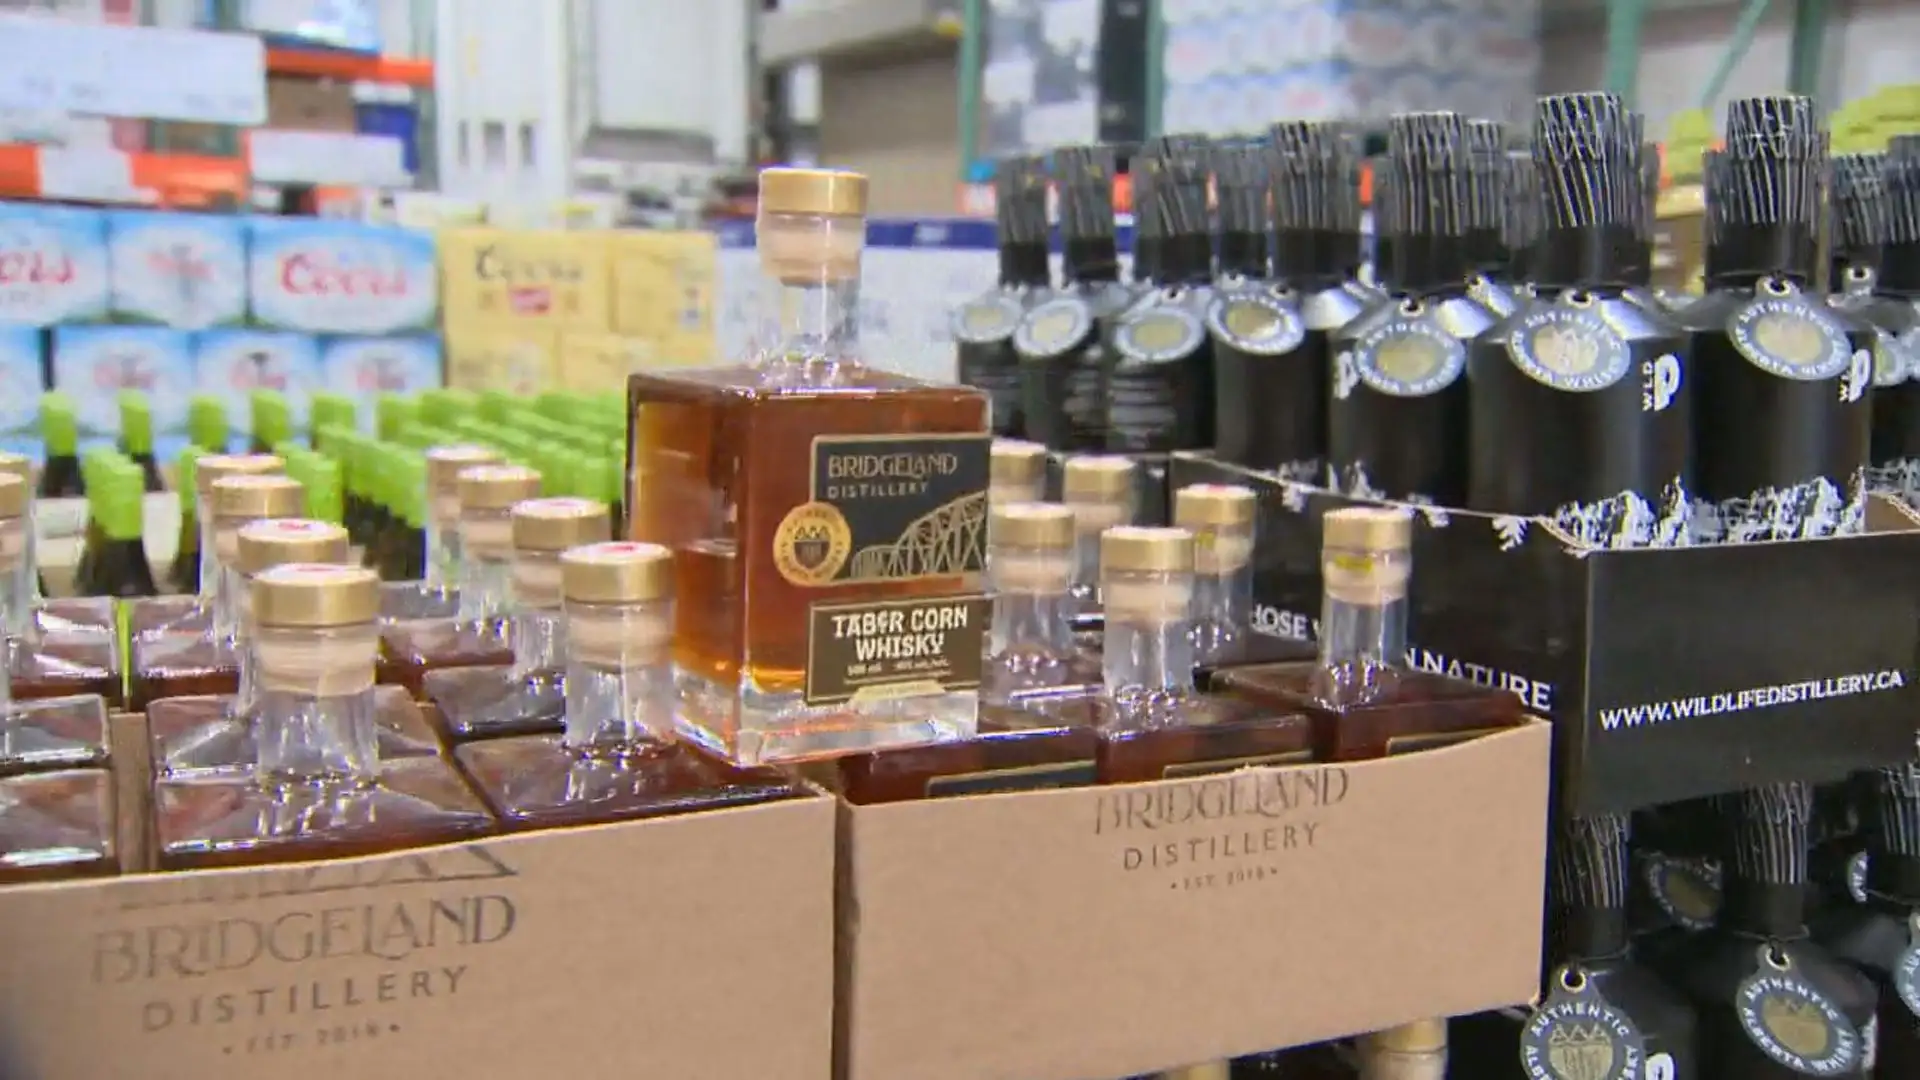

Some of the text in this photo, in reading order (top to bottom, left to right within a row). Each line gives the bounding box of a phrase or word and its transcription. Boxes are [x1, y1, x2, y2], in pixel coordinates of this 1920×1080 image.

[828, 451, 958, 480] BRIDGELAND
[827, 481, 929, 499] DISTILLERY
[831, 605, 968, 640] TABER CORN
[855, 632, 945, 662] WHISKY
[1422, 650, 1552, 712] NATURE
[1600, 669, 1904, 731] WWW.WILDLIFEDISTILLERY.CA
[1095, 767, 1349, 836] BRIDGELAND
[1123, 822, 1319, 870] DISTILLERY
[91, 894, 518, 984] BRIDGELAND
[142, 965, 468, 1033] DISTILLERY
[1531, 1001, 1631, 1039] AUTHENTIC
